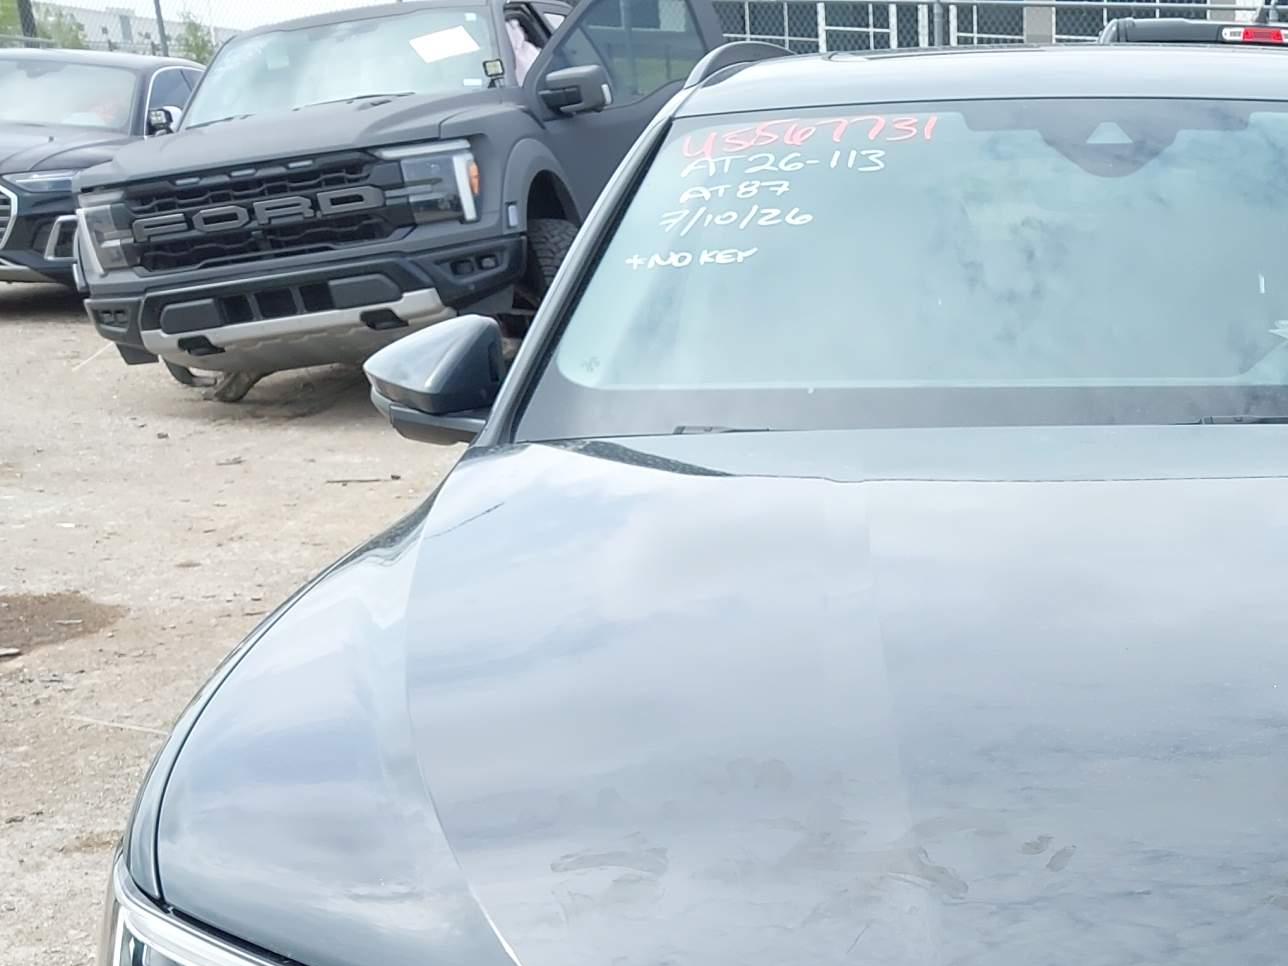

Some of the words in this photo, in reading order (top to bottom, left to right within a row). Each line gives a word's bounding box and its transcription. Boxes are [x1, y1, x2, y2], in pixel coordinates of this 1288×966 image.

[682, 115, 938, 158] 45567731
[131, 184, 386, 243] FORD
[659, 204, 814, 237] 7/10/26
[699, 247, 759, 266] KEY
